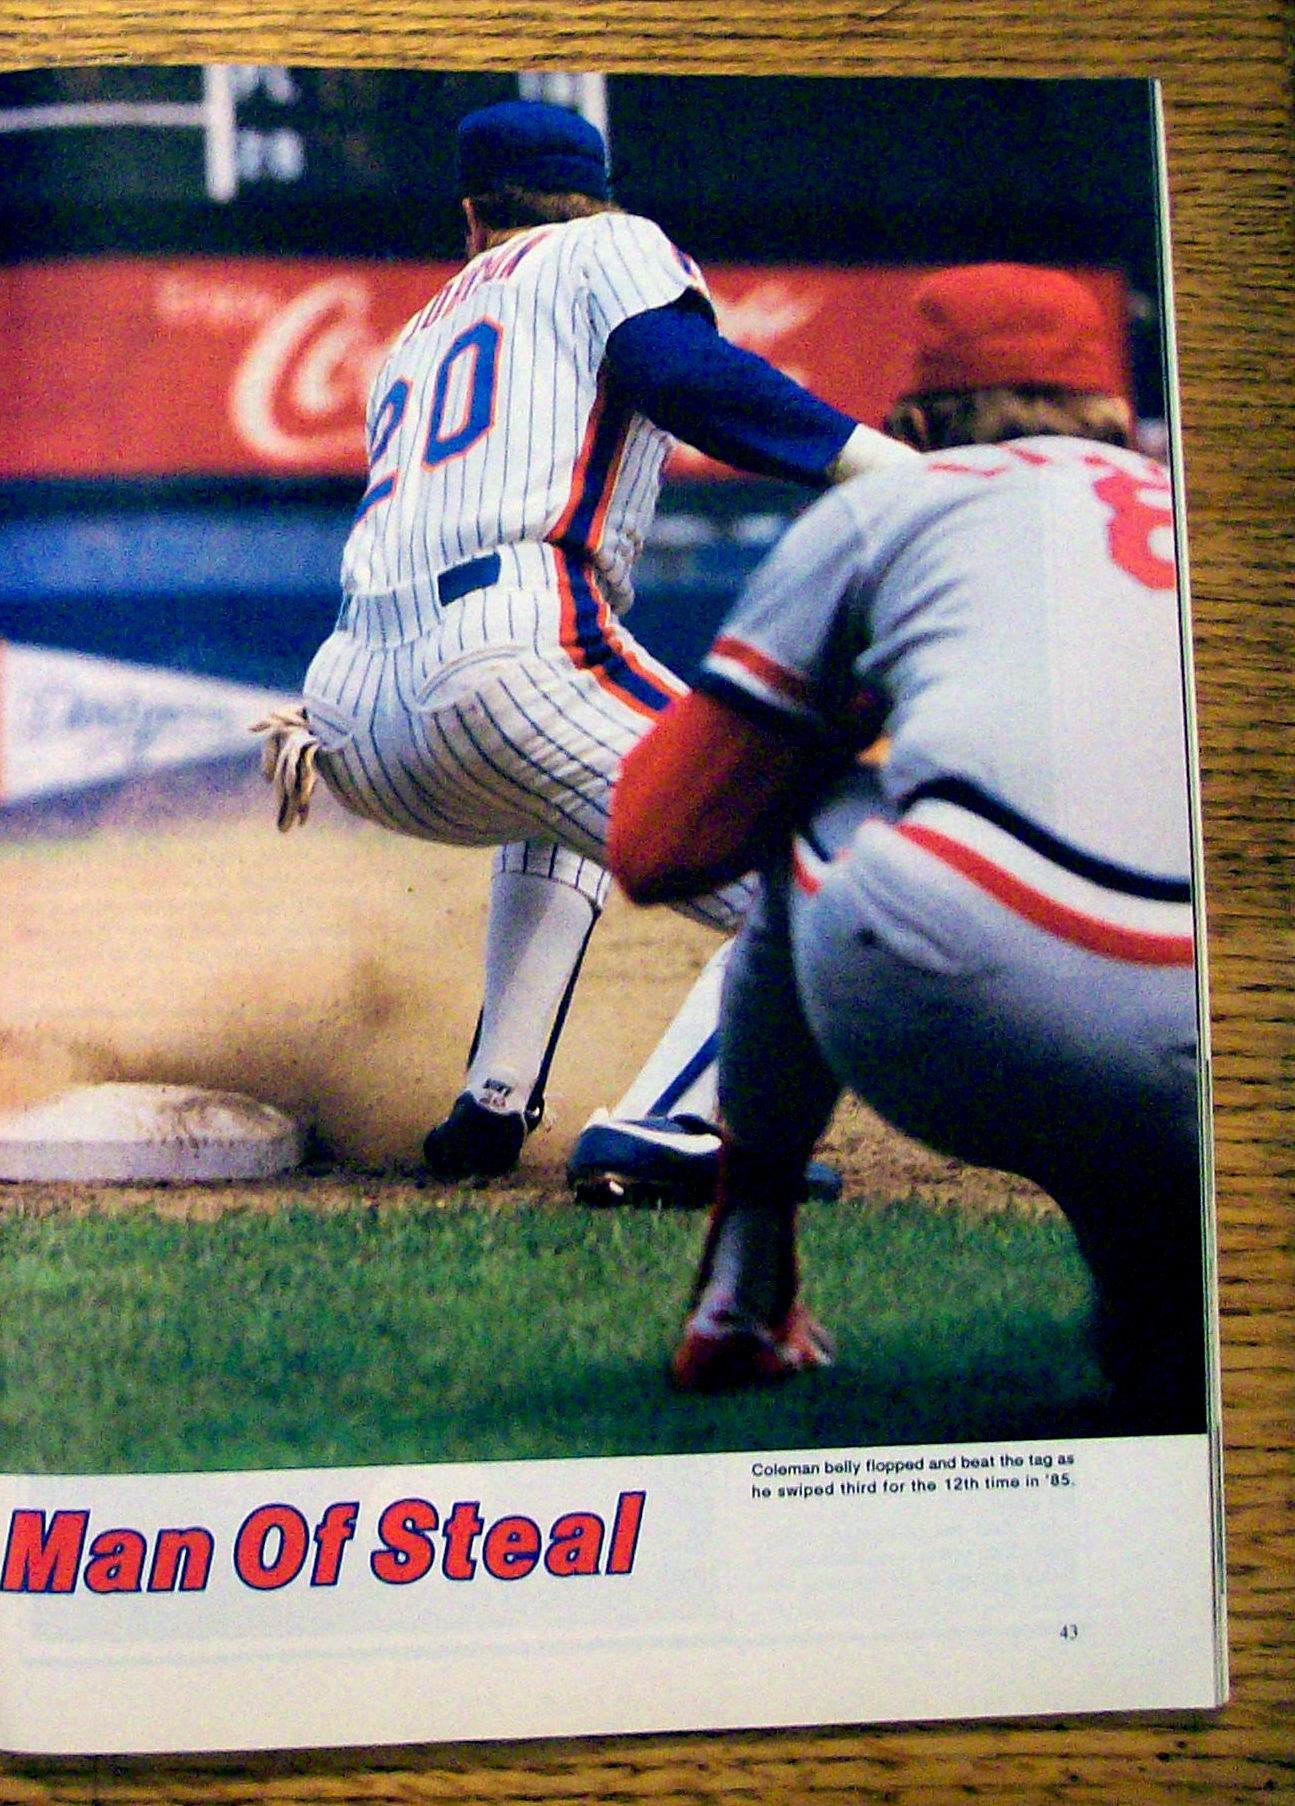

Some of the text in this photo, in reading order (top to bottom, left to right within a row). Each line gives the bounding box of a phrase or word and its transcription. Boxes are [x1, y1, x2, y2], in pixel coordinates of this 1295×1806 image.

[352, 315, 504, 525] 20
[751, 1453, 1074, 1476] Coleman belly flopped and beat the tag as
[751, 1473, 1074, 1499] he swiped third for the 12th time in '85.
[0, 1508, 215, 1594] Man
[234, 1501, 360, 1590] Of
[371, 1491, 646, 1584] Steal
[1059, 1624, 1078, 1639] 43
